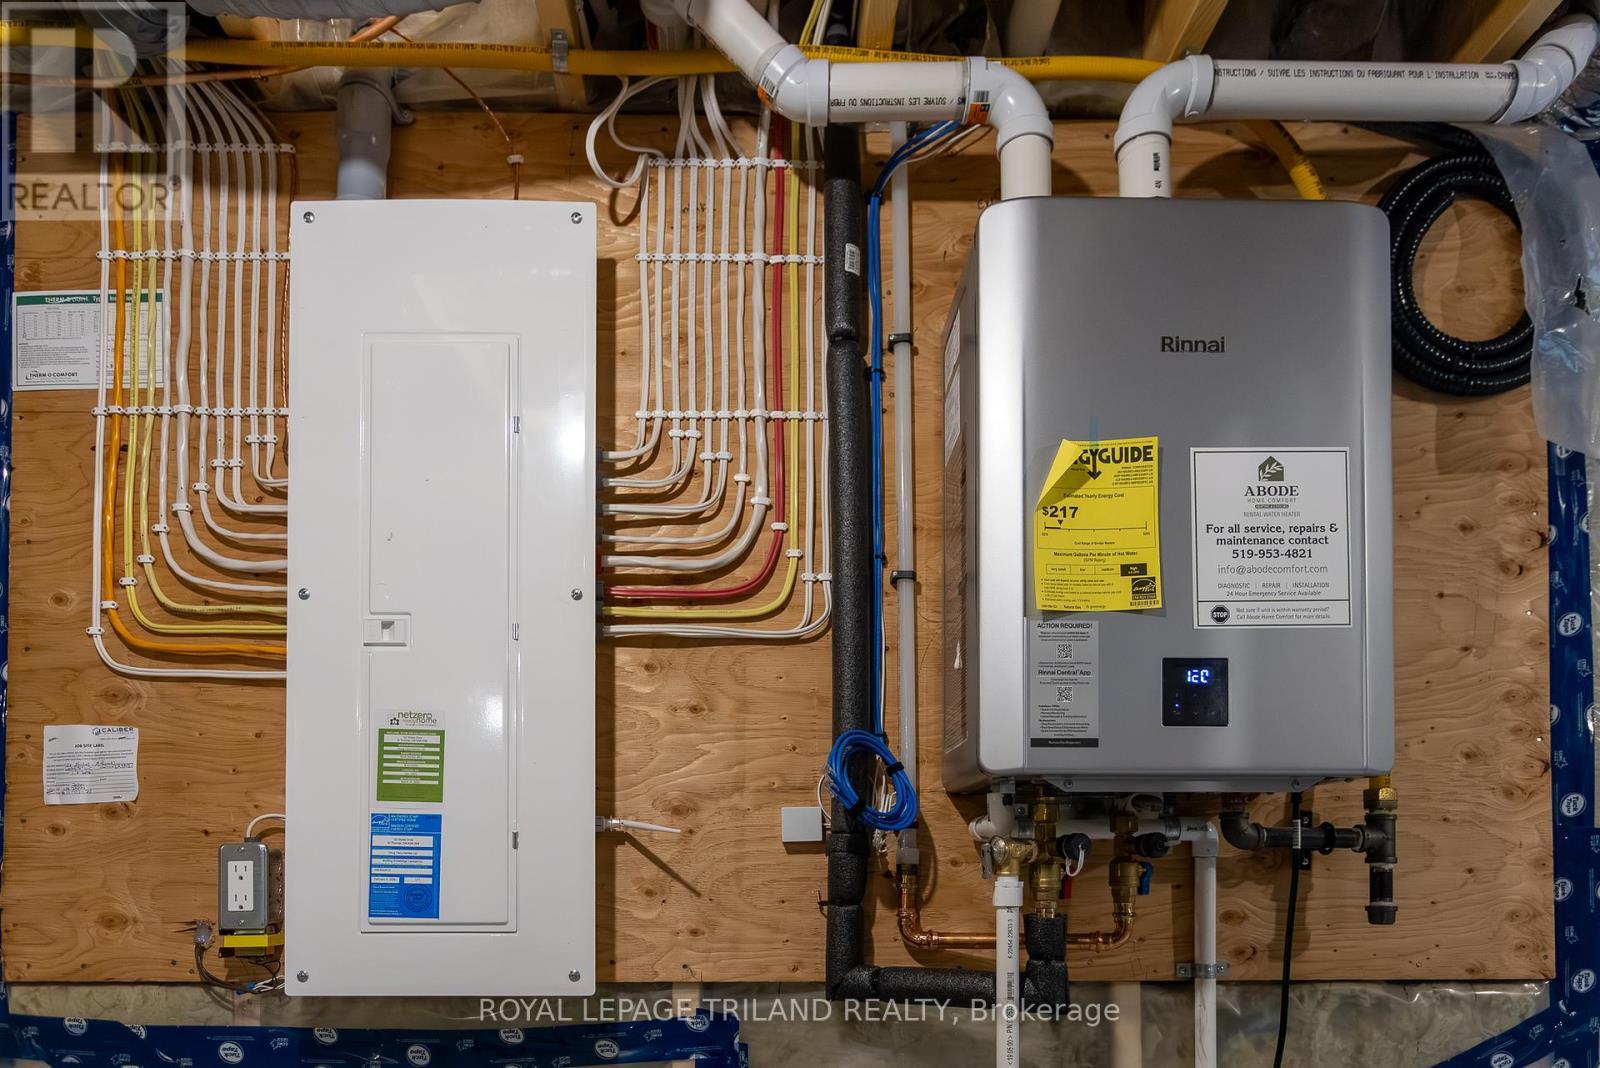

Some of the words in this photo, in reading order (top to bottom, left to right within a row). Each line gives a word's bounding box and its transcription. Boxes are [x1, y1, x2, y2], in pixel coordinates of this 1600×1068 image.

[1268, 68, 1290, 78] SUIVRE
[1294, 68, 1306, 78] LES
[1309, 69, 1354, 78] INSTRUCTIONS
[1356, 70, 1365, 78] DU
[1408, 70, 1424, 78] POUR
[848, 98, 857, 106] DU
[860, 98, 904, 106] INSTRUCTIONS
[908, 97, 920, 106] LES
[924, 96, 946, 106] SUIVRE
[1161, 336, 1225, 353] Rinnai
[1244, 485, 1300, 497] ABODE
[1042, 505, 1079, 518] $217
[1206, 524, 1224, 534] For
[1228, 524, 1240, 533] all
[1244, 524, 1286, 535] service,
[1288, 524, 1326, 536] repairs
[1329, 523, 1338, 533] &
[1216, 536, 1285, 546] maintenance
[1288, 535, 1329, 545] contact
[1232, 549, 1312, 558] 519-953-4821
[1218, 564, 1328, 575] info@abodecomfort.com
[1248, 590, 1276, 598] Emergency
[398, 711, 432, 719] netzero
